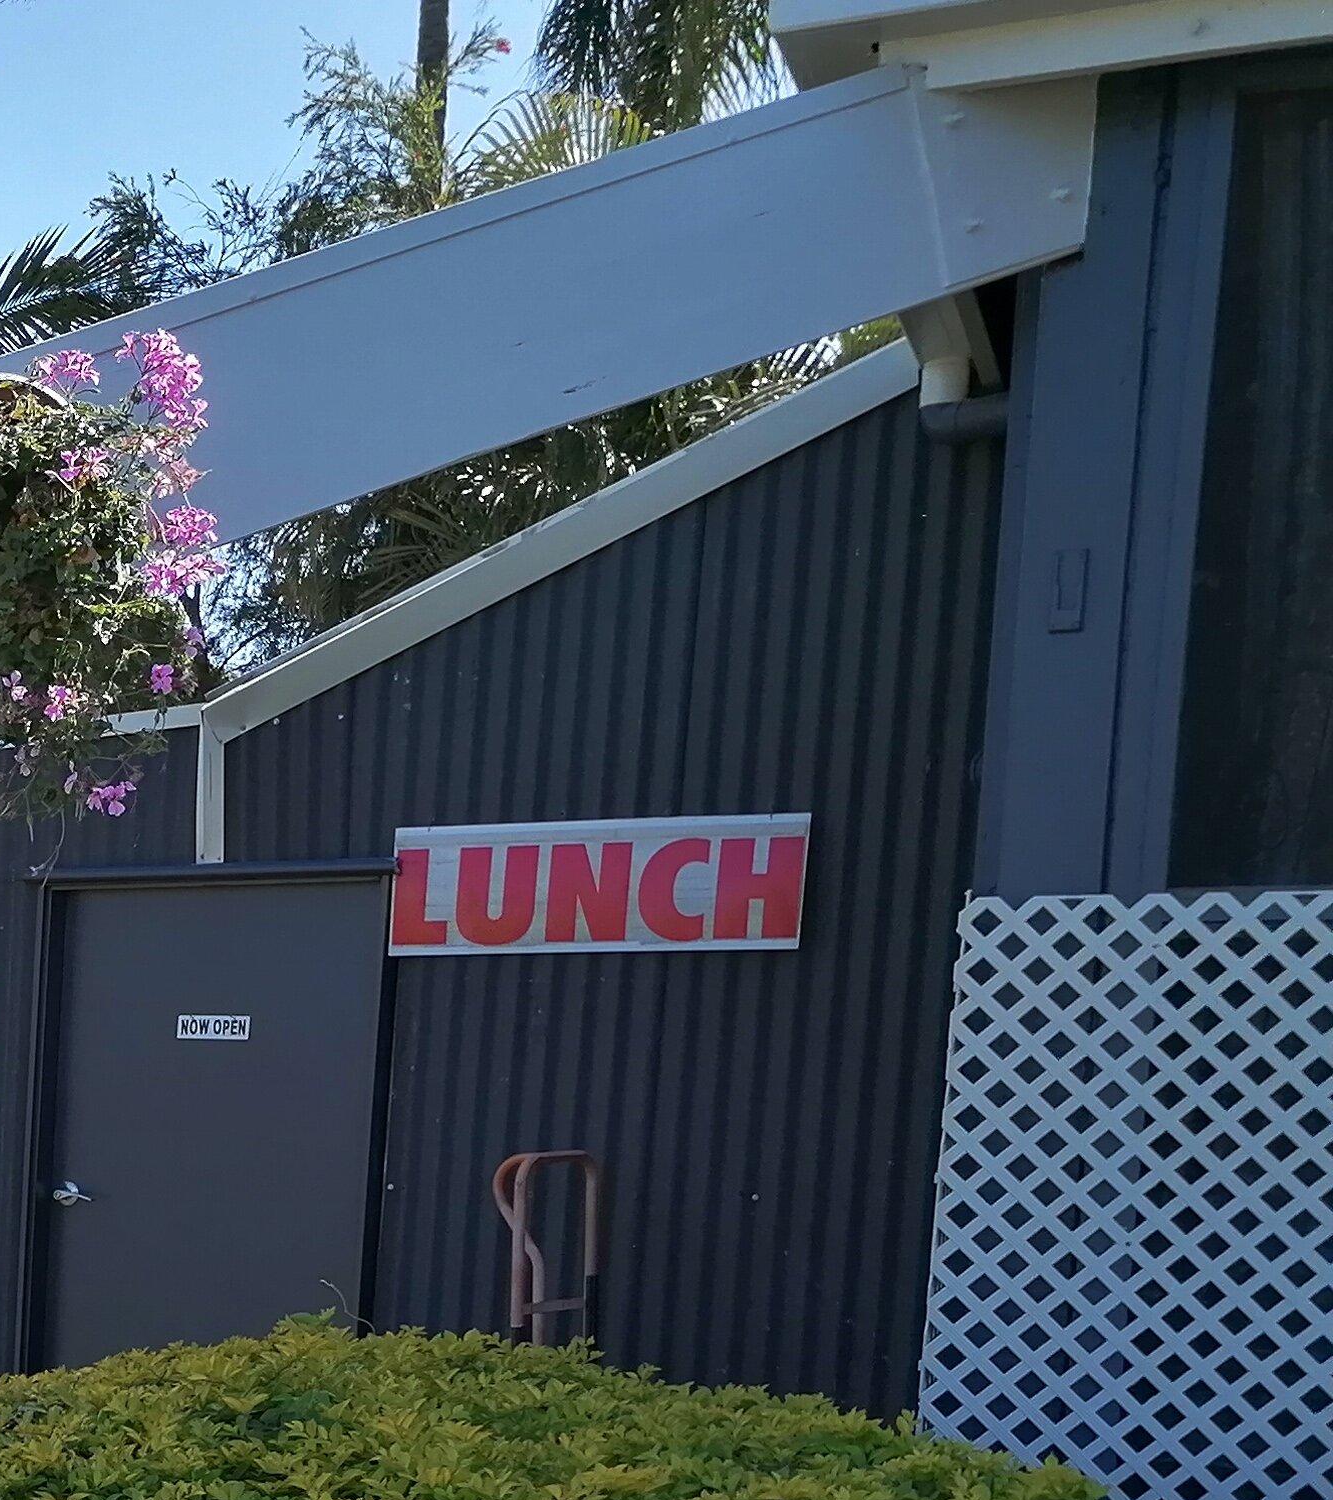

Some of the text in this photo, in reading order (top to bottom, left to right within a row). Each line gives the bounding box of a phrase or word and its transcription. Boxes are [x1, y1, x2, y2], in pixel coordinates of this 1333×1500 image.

[391, 836, 806, 946] LUNCH
[181, 1019, 247, 1035] NOW OPEN
